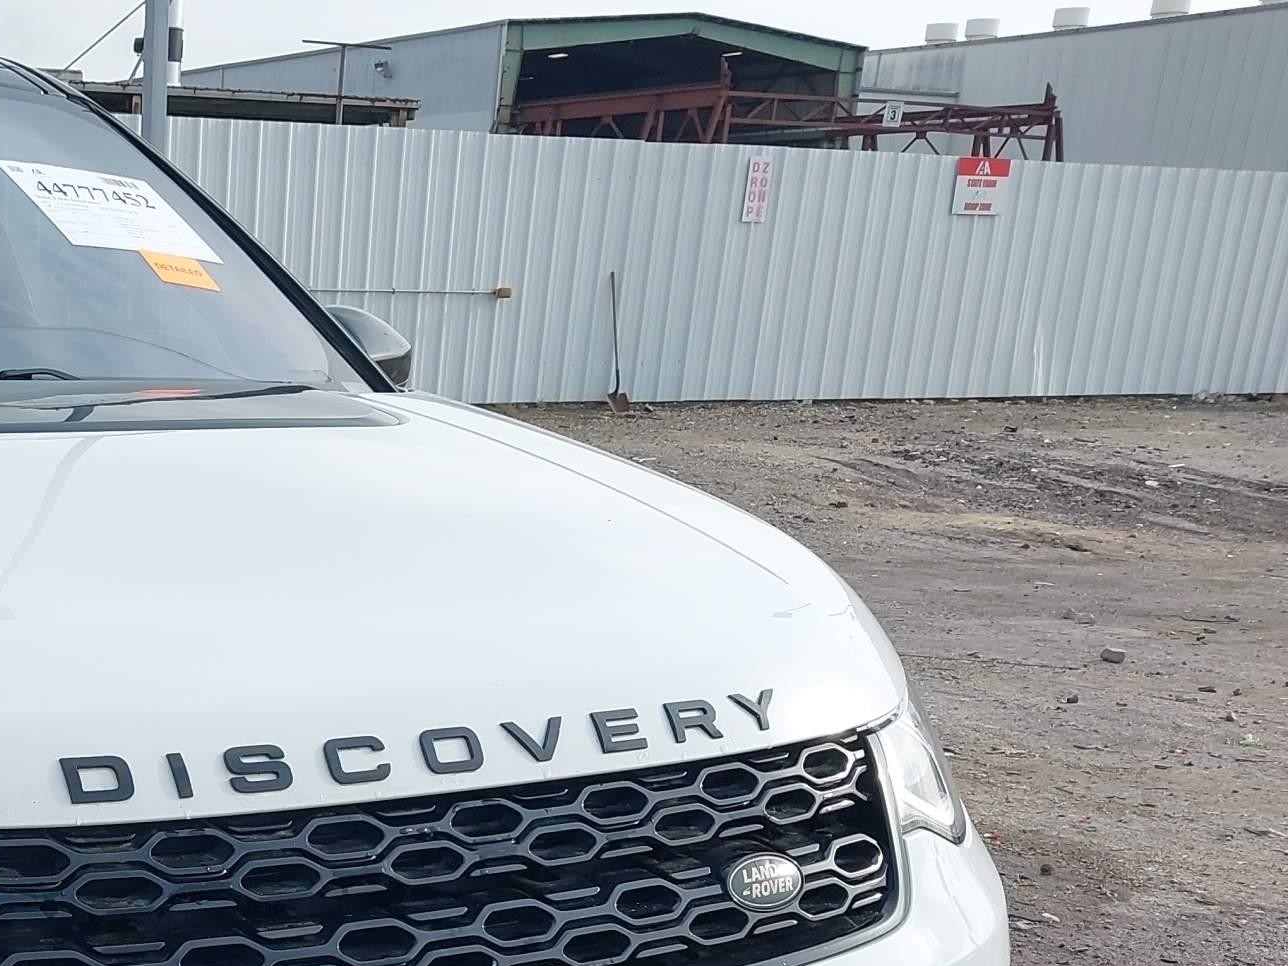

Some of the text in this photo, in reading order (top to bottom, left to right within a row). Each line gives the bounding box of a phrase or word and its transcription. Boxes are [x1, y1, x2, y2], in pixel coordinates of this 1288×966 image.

[36, 180, 157, 210] 44777452
[57, 687, 775, 805] DISCOVERY
[742, 863, 778, 884] LAND
[751, 876, 794, 899] ROVER
